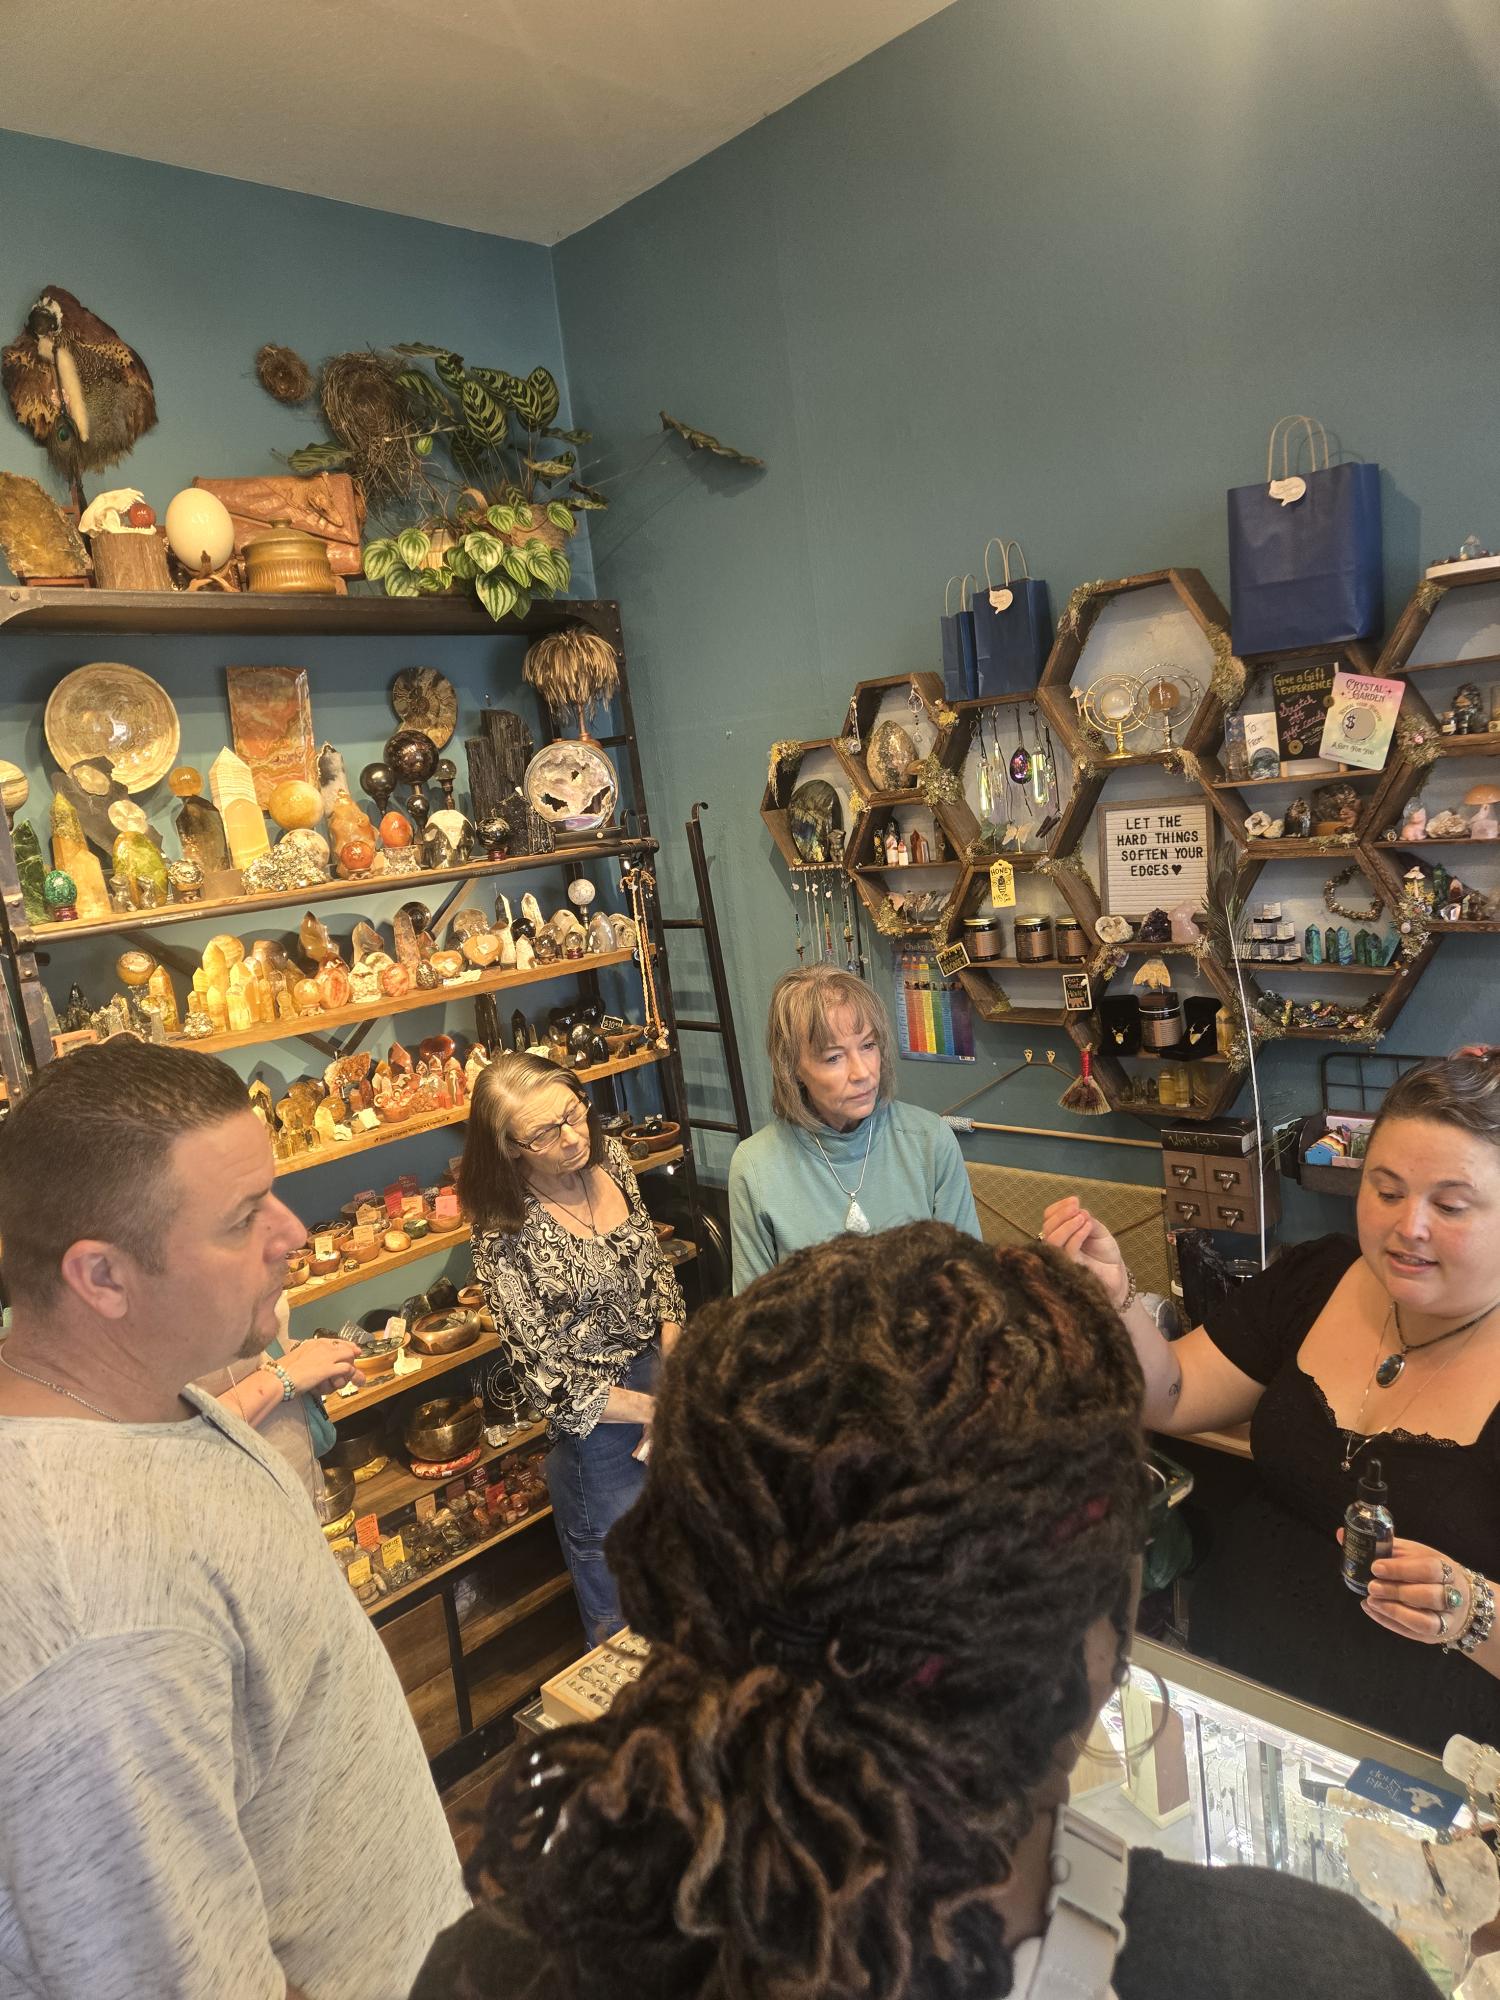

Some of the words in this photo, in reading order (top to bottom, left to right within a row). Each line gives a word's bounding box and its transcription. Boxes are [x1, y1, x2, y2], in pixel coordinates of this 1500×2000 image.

[1281, 679, 1332, 695] EXPERIENCE
[1346, 679, 1384, 693] CRYSTAL
[1351, 690, 1386, 702] GARDEN
[1346, 714, 1356, 731] $
[1126, 818, 1150, 830] LET
[1158, 815, 1182, 828] THE
[1117, 834, 1147, 846] HARD
[1155, 831, 1199, 844] THINGS
[1121, 849, 1168, 861] SOFTEN
[1175, 846, 1203, 859] YOUR
[991, 867, 1013, 876] HONEY
[1131, 864, 1169, 877] EDGES
